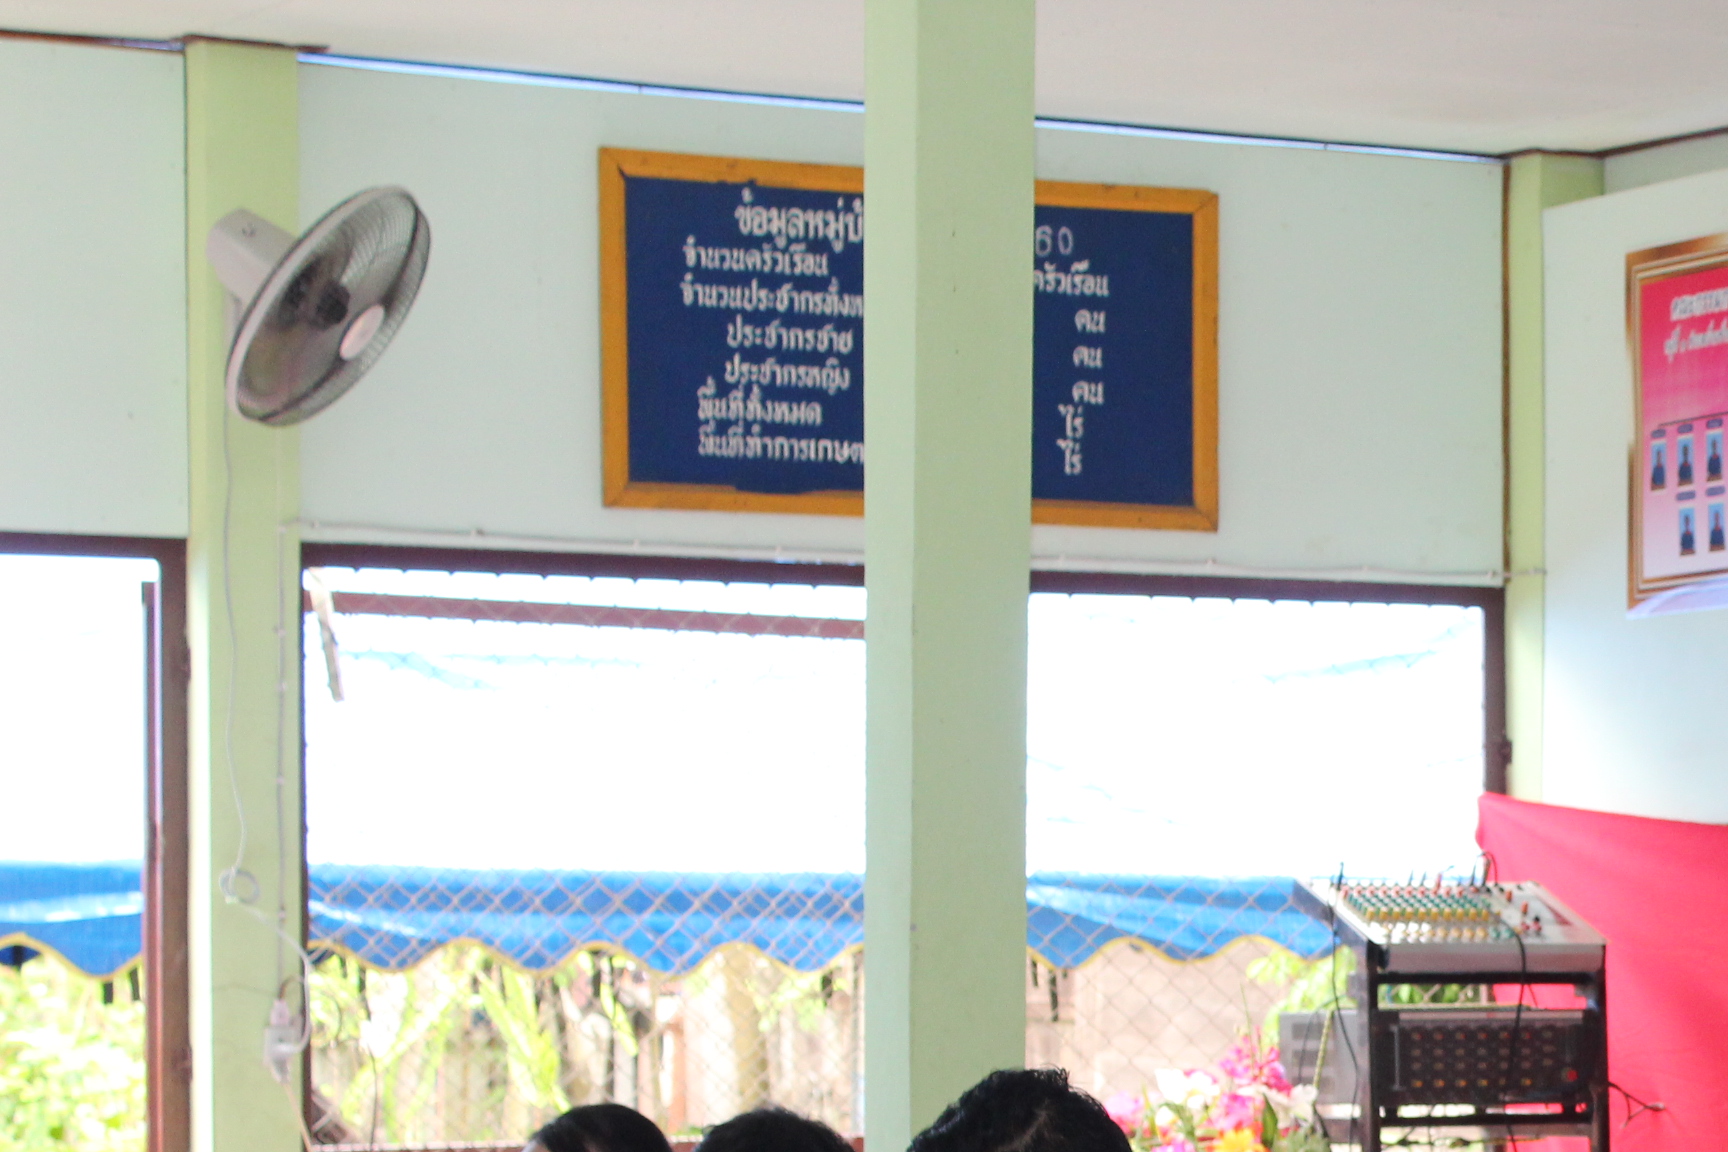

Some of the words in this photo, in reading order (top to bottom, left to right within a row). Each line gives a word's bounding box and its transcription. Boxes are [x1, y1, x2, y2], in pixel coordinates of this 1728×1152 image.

[683, 235, 829, 277] จำนวนครัวเรือน
[727, 315, 853, 354] ประชากรชาย
[1074, 308, 1105, 334] คน
[724, 352, 851, 396] ประชากรหญิง
[1072, 343, 1102, 369] คน
[697, 377, 822, 427] พื้นที่ทั้งหมด
[1072, 379, 1104, 405] คน
[1058, 404, 1084, 440] ไร่
[1057, 439, 1082, 476] ไร่
